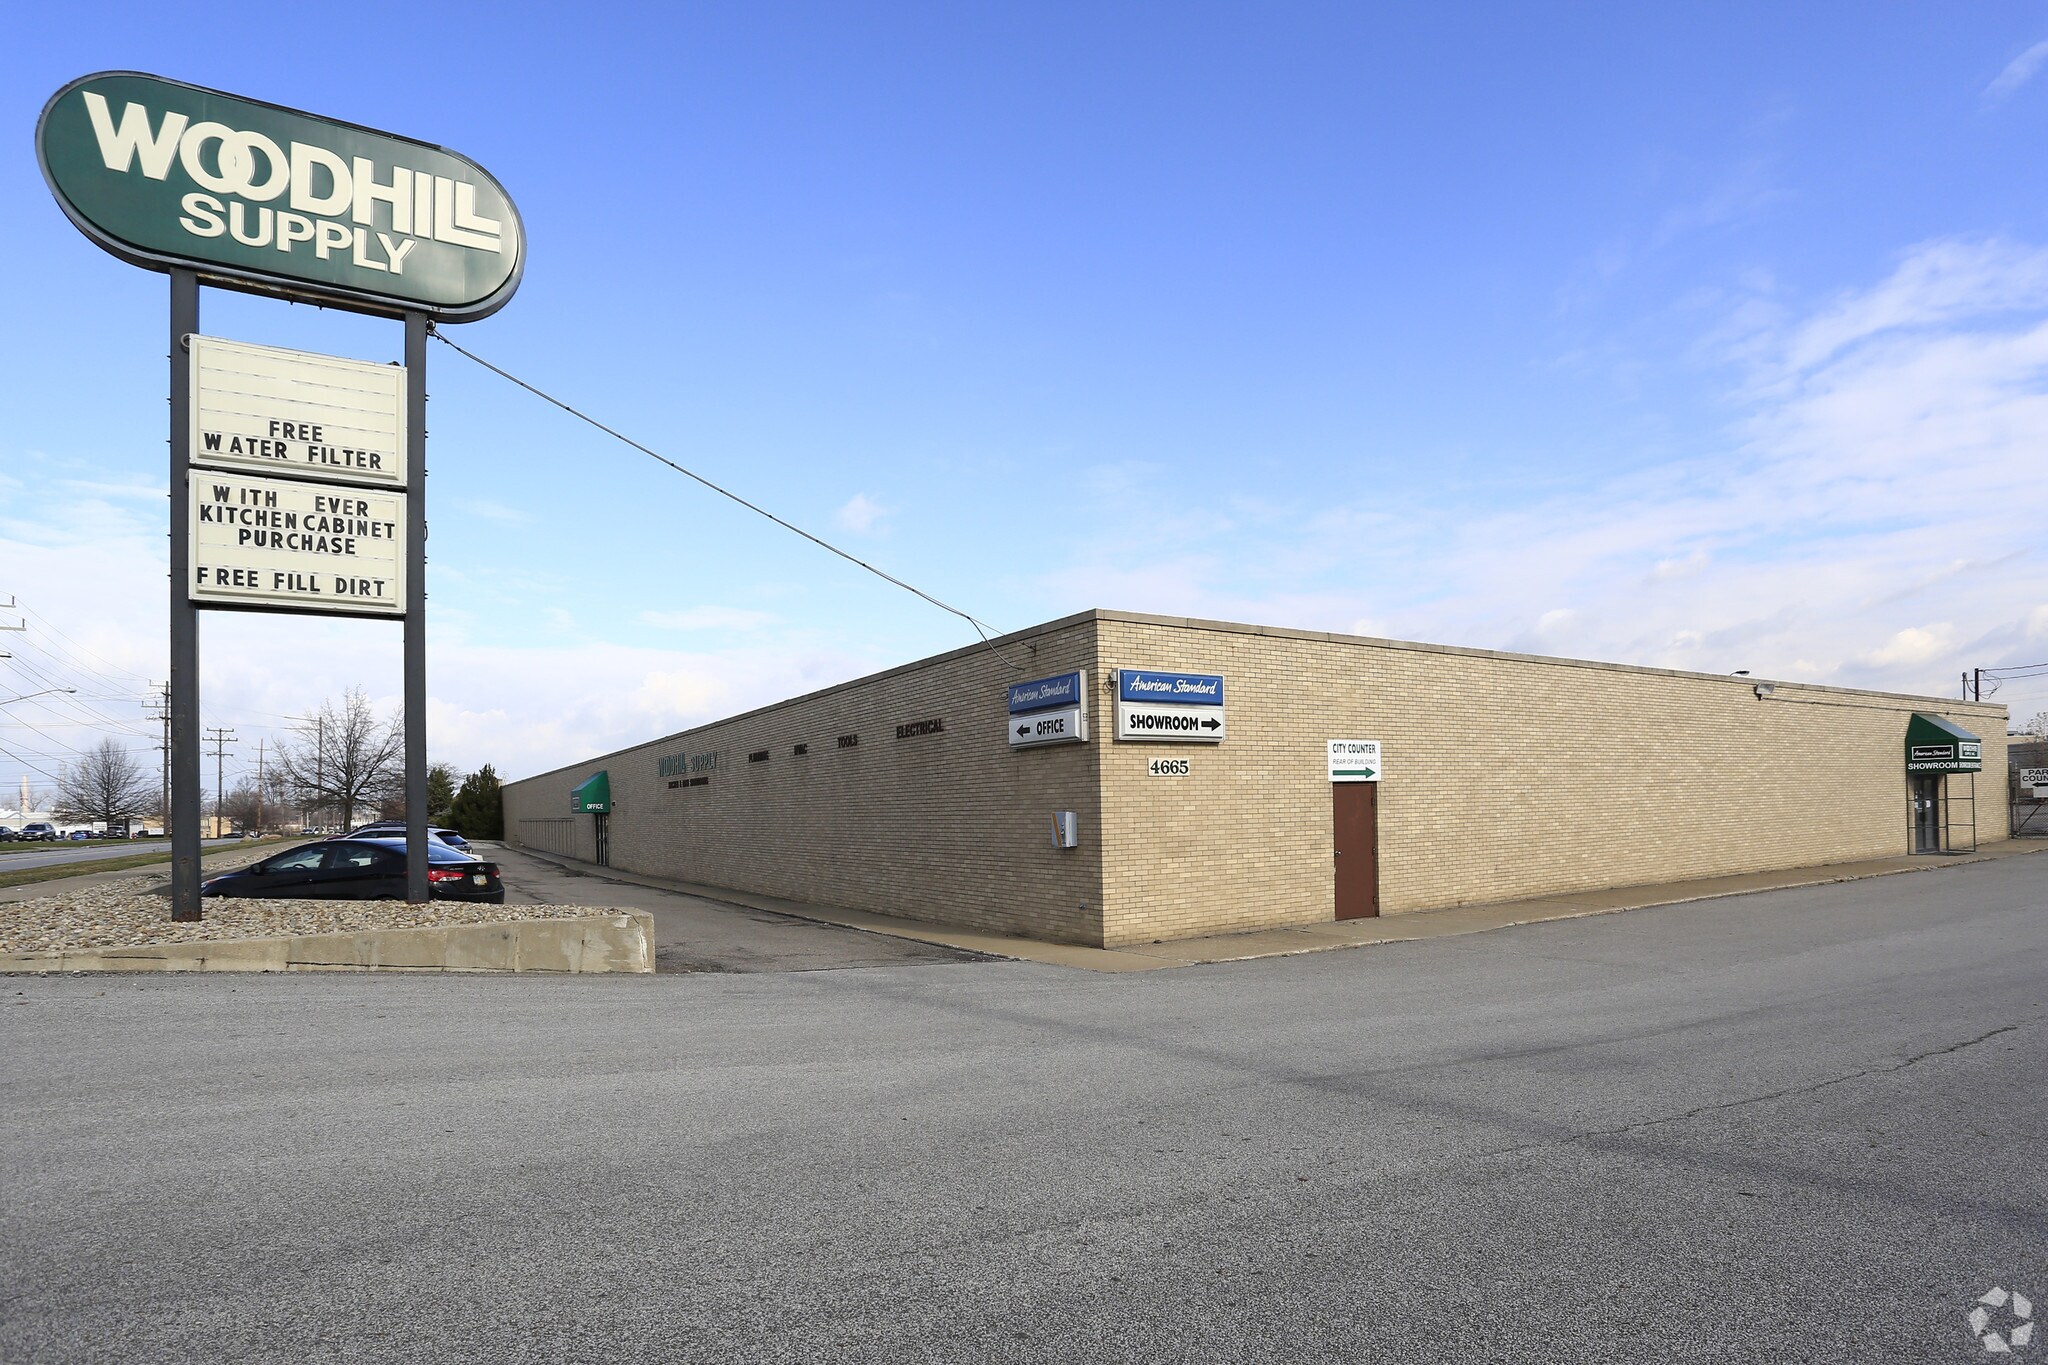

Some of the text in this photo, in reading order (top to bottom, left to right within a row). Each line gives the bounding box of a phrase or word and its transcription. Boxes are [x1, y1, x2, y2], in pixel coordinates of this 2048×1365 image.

[82, 91, 501, 252] WOODHILL
[179, 193, 417, 275] SUPPLY
[269, 420, 323, 442] FREE
[204, 432, 382, 469] WATER FILTER
[213, 485, 369, 517] WITH EVER
[200, 504, 395, 539] KITCHEN CABINET
[239, 528, 356, 554] PURCHASE
[197, 567, 385, 597] FREE FILL DIRT
[1012, 679, 1071, 704] American Standard
[1130, 675, 1218, 695] American Standard
[896, 718, 944, 739] ELECTRICAL
[1036, 718, 1064, 736] OFFICE
[1130, 714, 1199, 731] SHOWROOM
[837, 734, 858, 749] TOOLS
[1332, 743, 1376, 754] CITY COUNTER
[690, 751, 718, 772] SUPPLY
[1150, 759, 1189, 774] 4665
[1907, 761, 1958, 770] SHOWROOM
